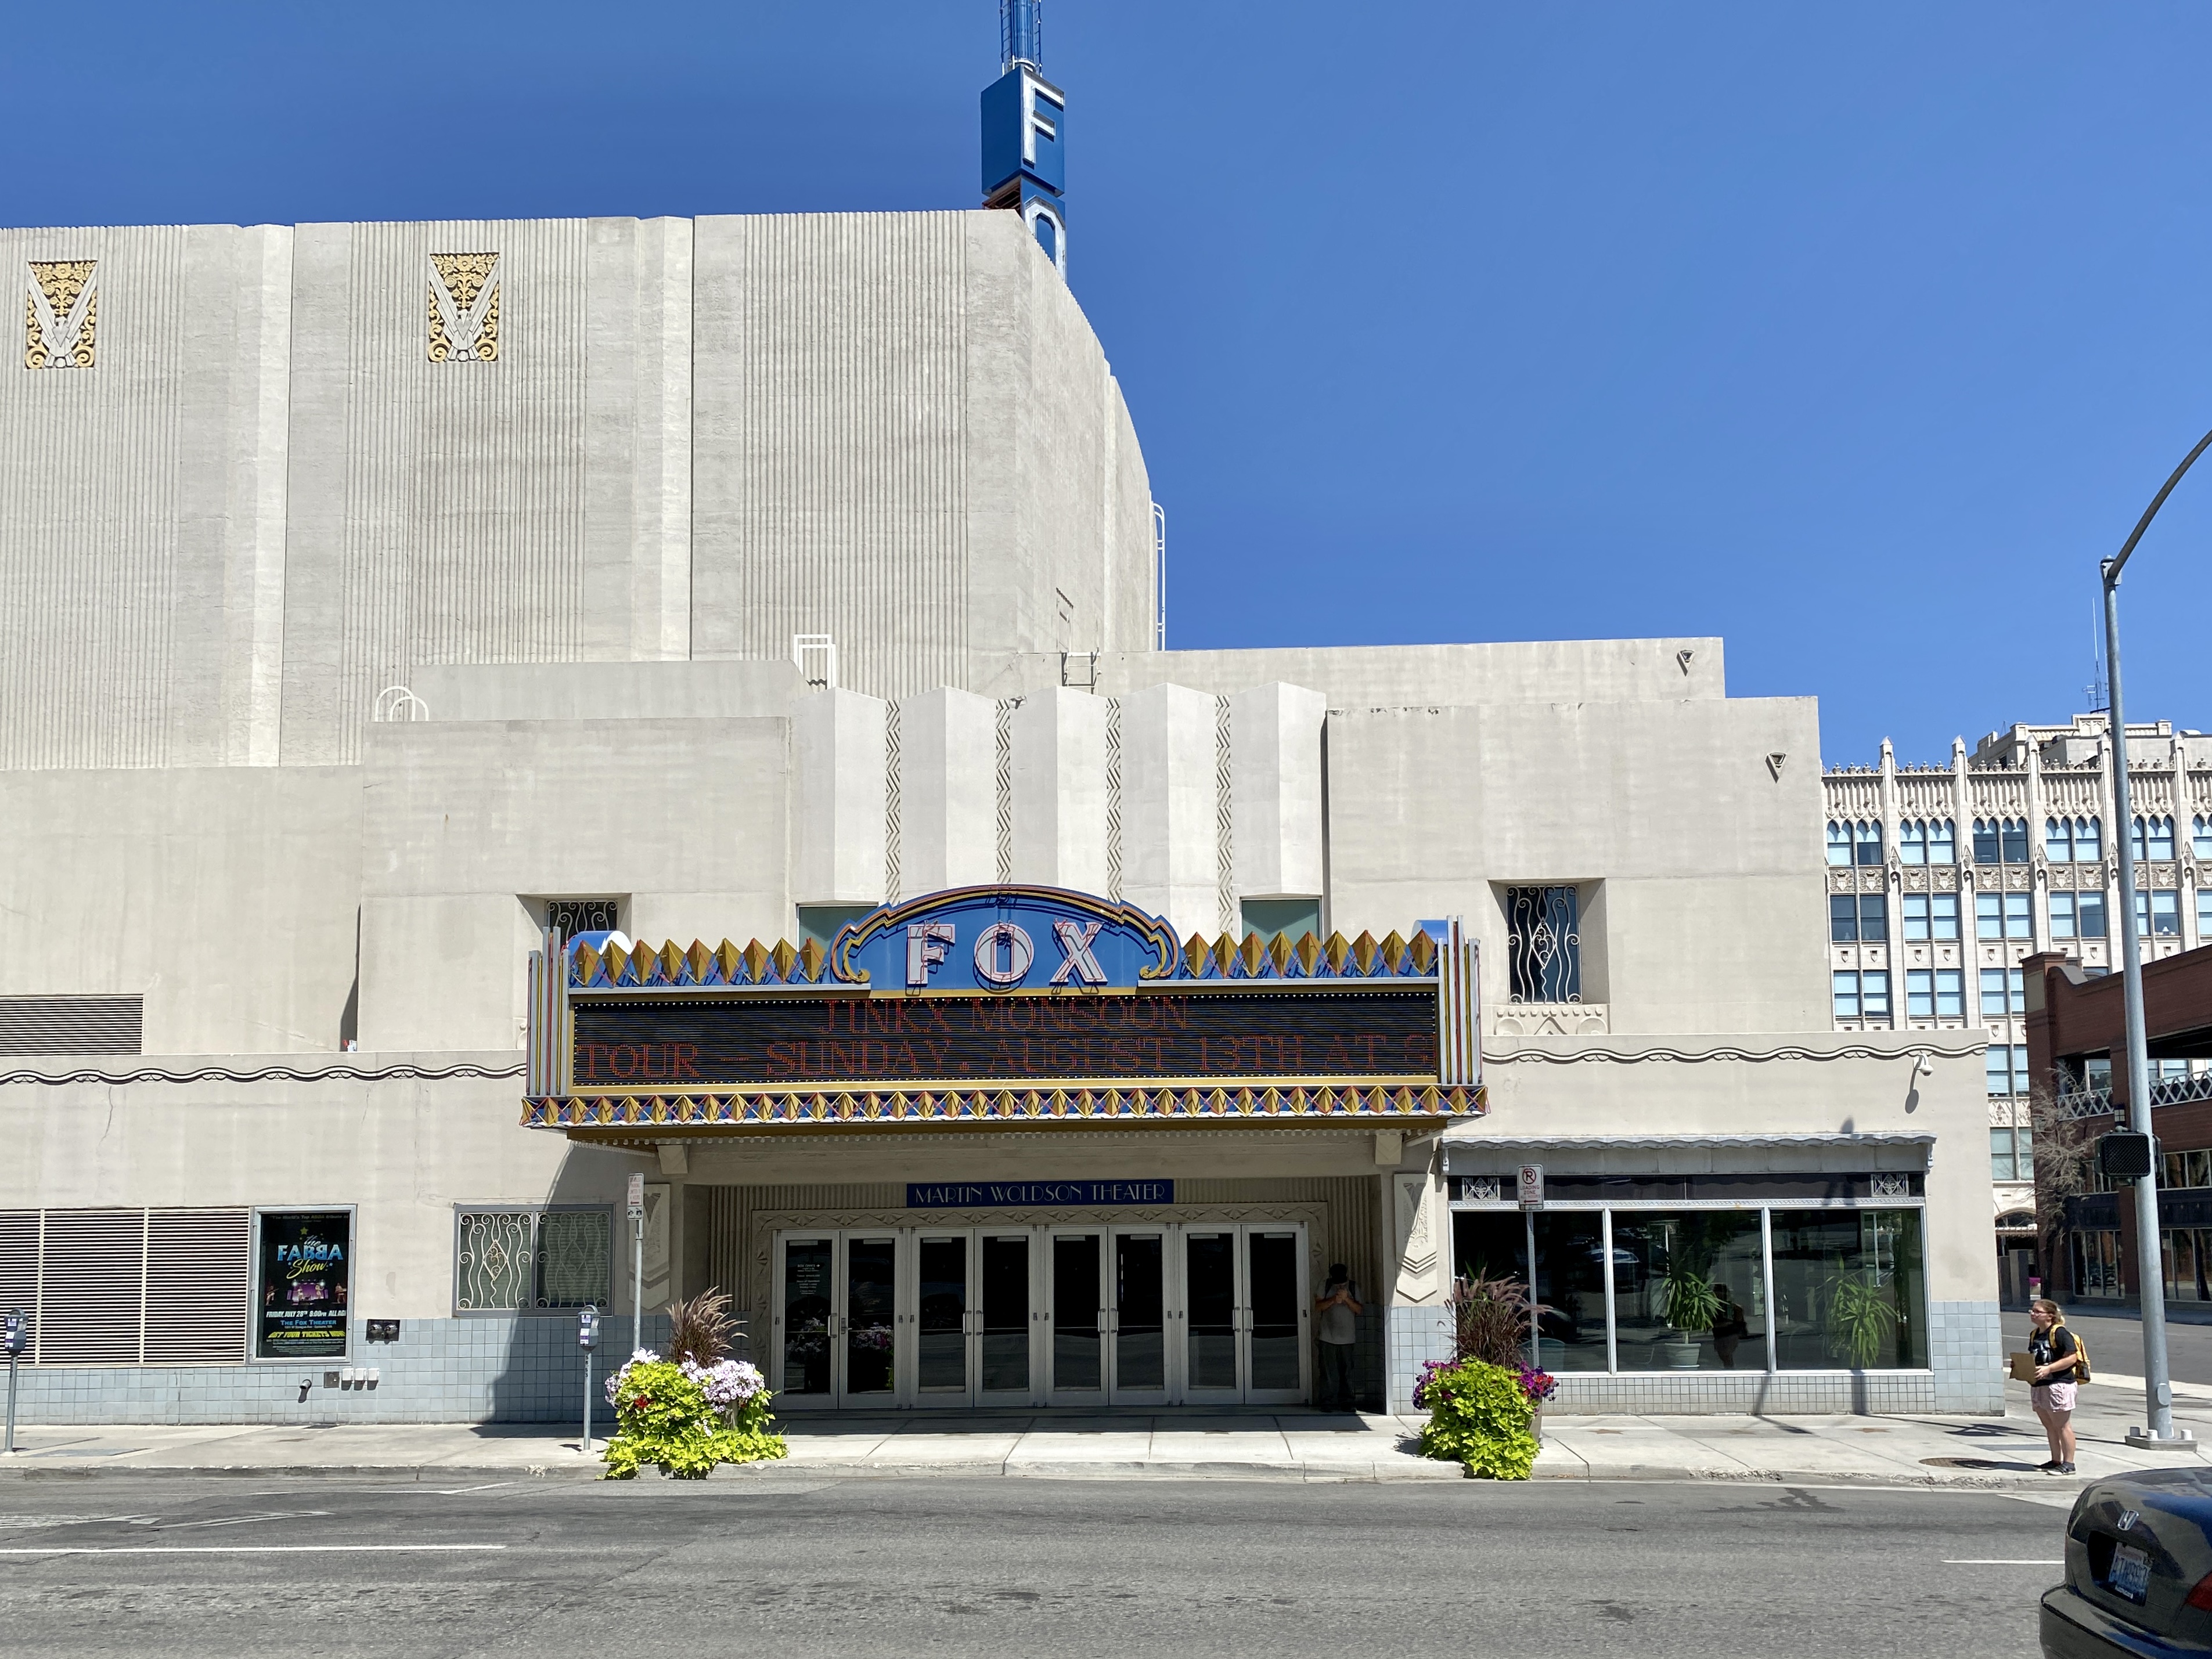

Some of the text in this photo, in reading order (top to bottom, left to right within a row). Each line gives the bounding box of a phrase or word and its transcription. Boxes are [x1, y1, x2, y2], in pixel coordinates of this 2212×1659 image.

[907, 921, 1108, 987] FOX
[971, 996, 1187, 1032] MONSOON
[576, 1044, 700, 1078] TOUR
[989, 1037, 1172, 1073] AUGUST
[1199, 1035, 1304, 1070] 13TH
[1323, 1034, 1386, 1069] AT
[916, 1184, 1165, 1203] MARTIN WOLDSON THEATER
[304, 1235, 322, 1247] the
[277, 1245, 344, 1261] FABBA
[286, 1258, 328, 1279] Show
